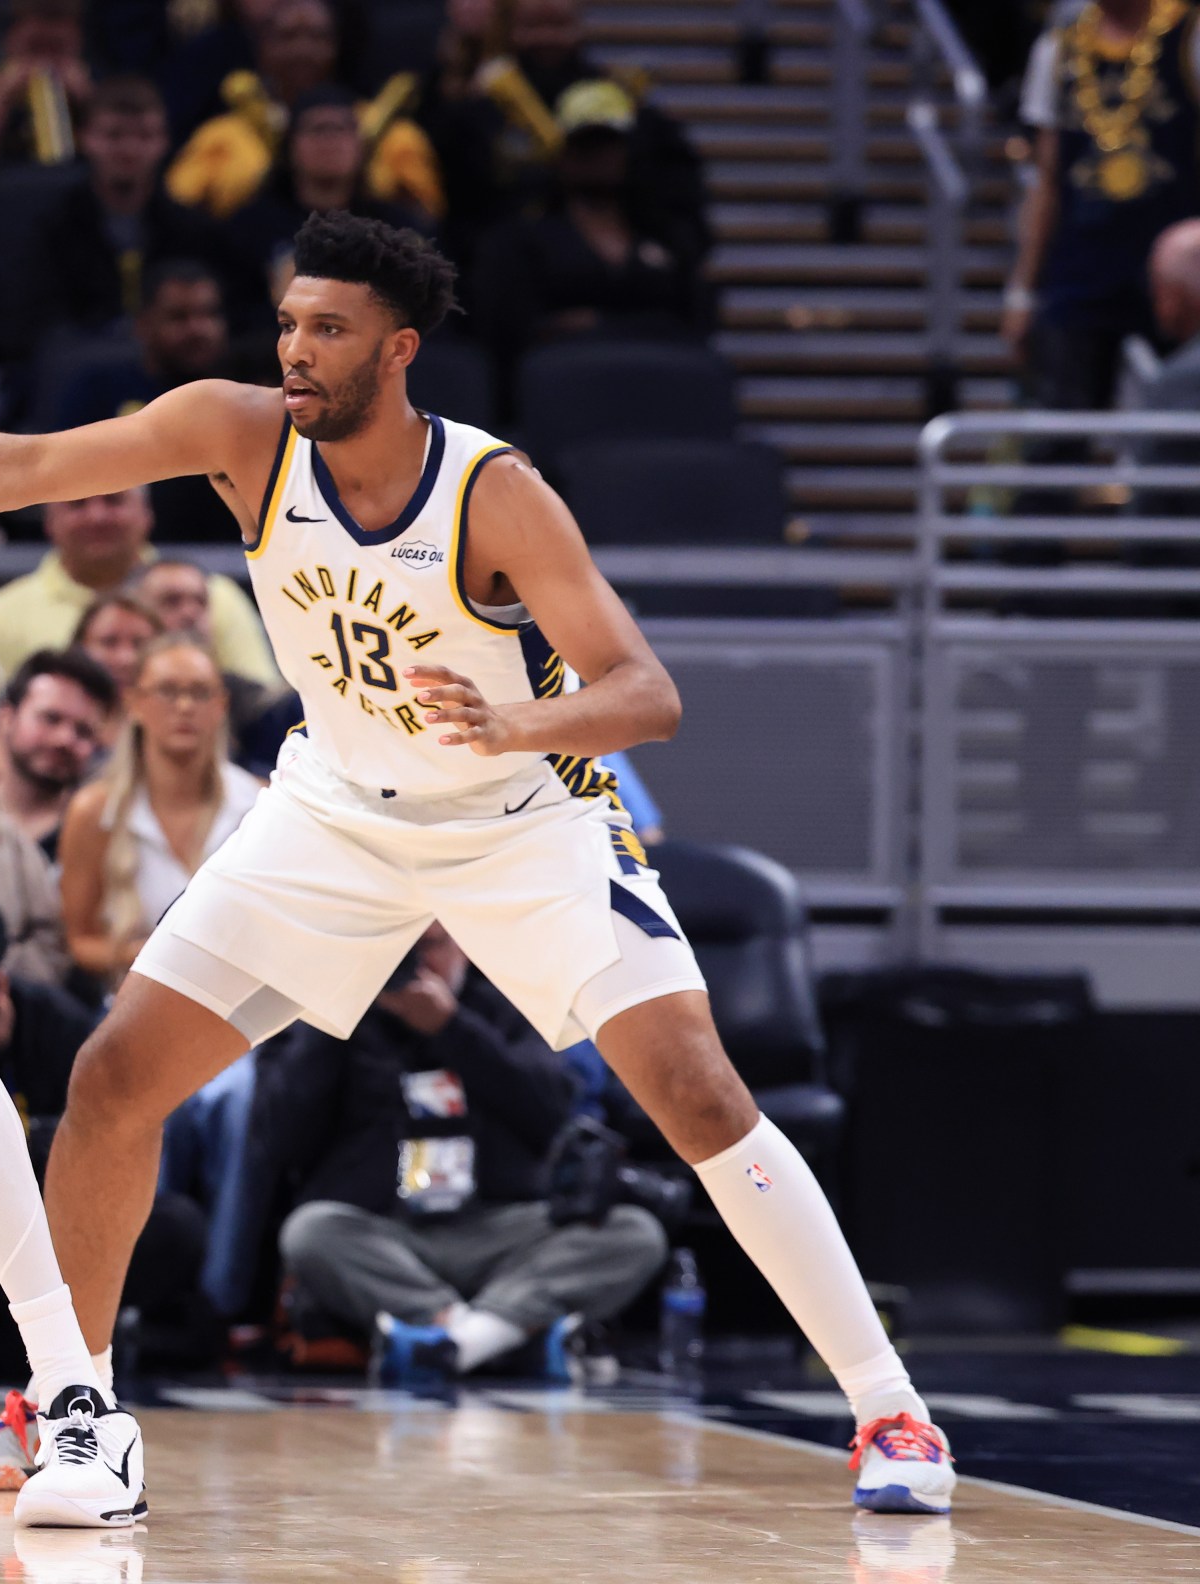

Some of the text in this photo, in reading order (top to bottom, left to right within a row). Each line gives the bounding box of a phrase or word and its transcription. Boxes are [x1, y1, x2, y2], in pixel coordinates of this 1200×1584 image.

[391, 547, 444, 562] LUCAS OIL
[281, 565, 442, 651] INDIANA
[330, 610, 399, 692] 13
